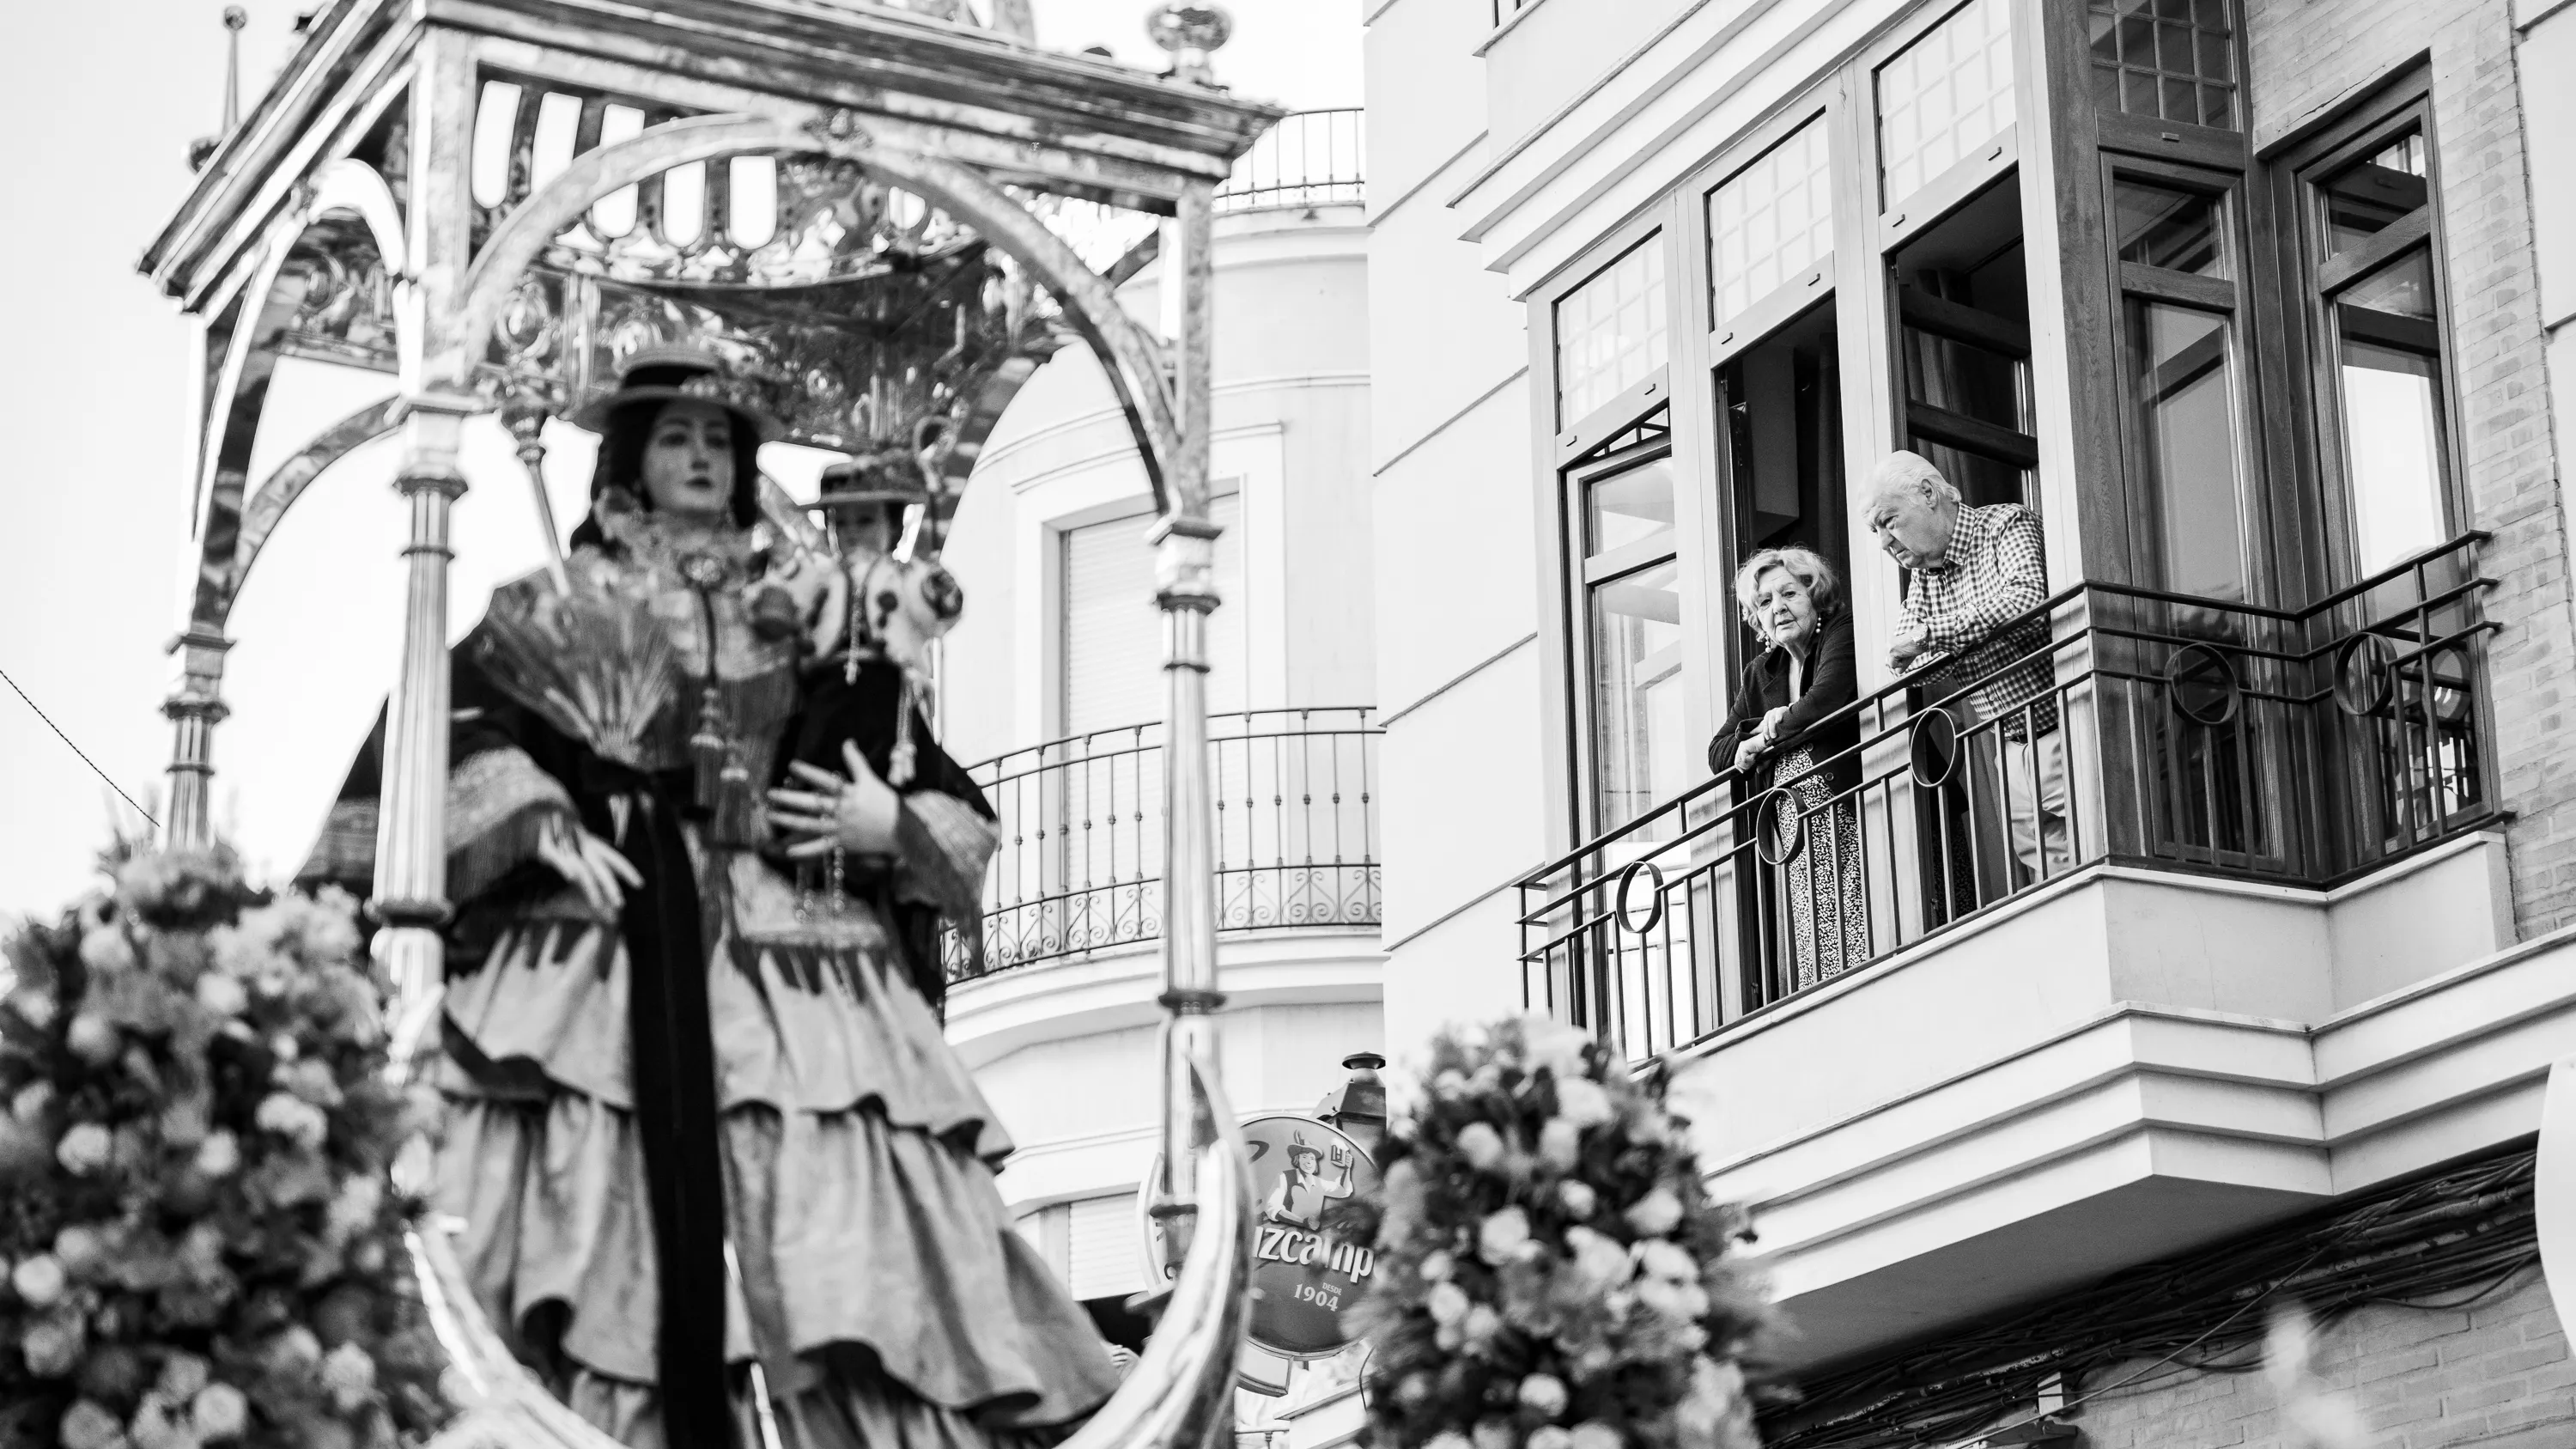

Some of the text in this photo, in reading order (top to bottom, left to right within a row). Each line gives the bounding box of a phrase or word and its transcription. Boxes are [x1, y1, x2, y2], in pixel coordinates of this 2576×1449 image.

[1253, 1226, 1375, 1283] zcamp
[1294, 1283, 1339, 1312] 1904
[1322, 1282, 1342, 1295] DESDE
